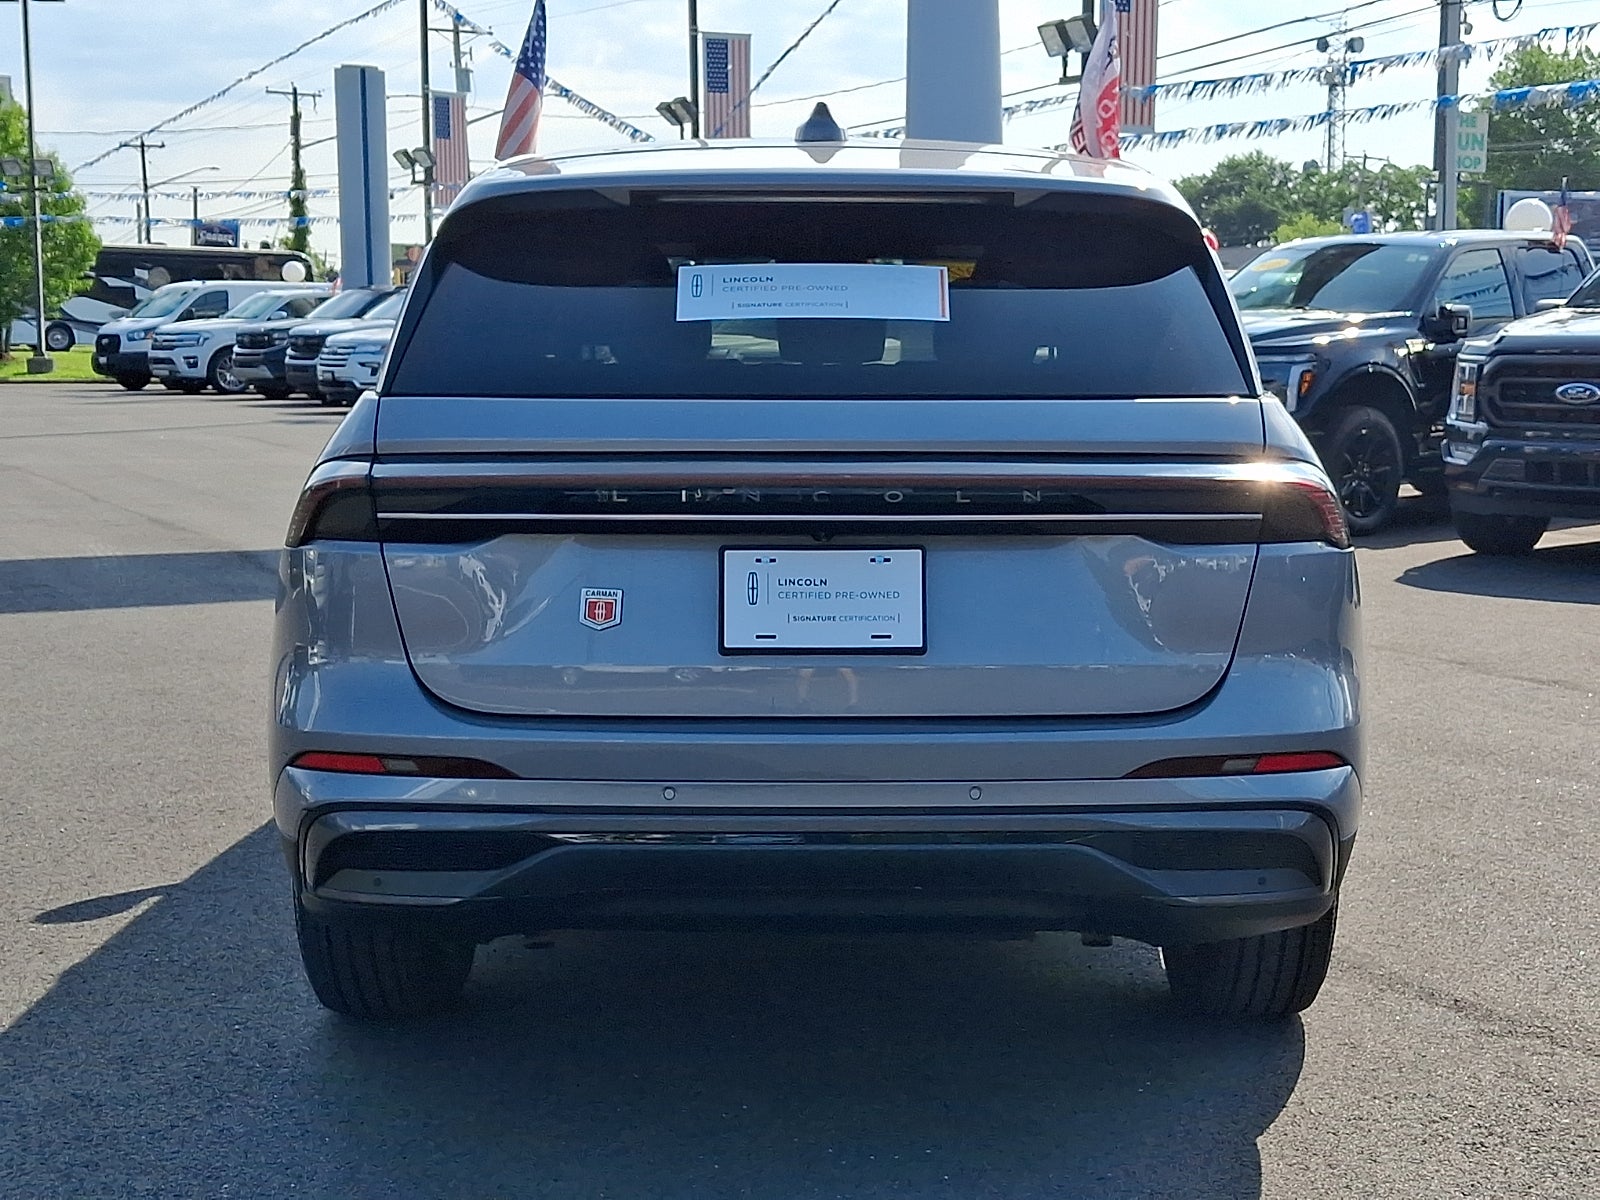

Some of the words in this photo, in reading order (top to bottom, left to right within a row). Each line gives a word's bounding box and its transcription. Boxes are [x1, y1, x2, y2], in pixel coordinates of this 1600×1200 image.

[1457, 115, 1477, 128] HE
[1457, 132, 1485, 151] UN
[612, 489, 1042, 502] LINCOLN
[777, 578, 828, 587] LINCOLN
[777, 591, 831, 600] CERTIFIED
[835, 591, 900, 600] PRE-OWNED
